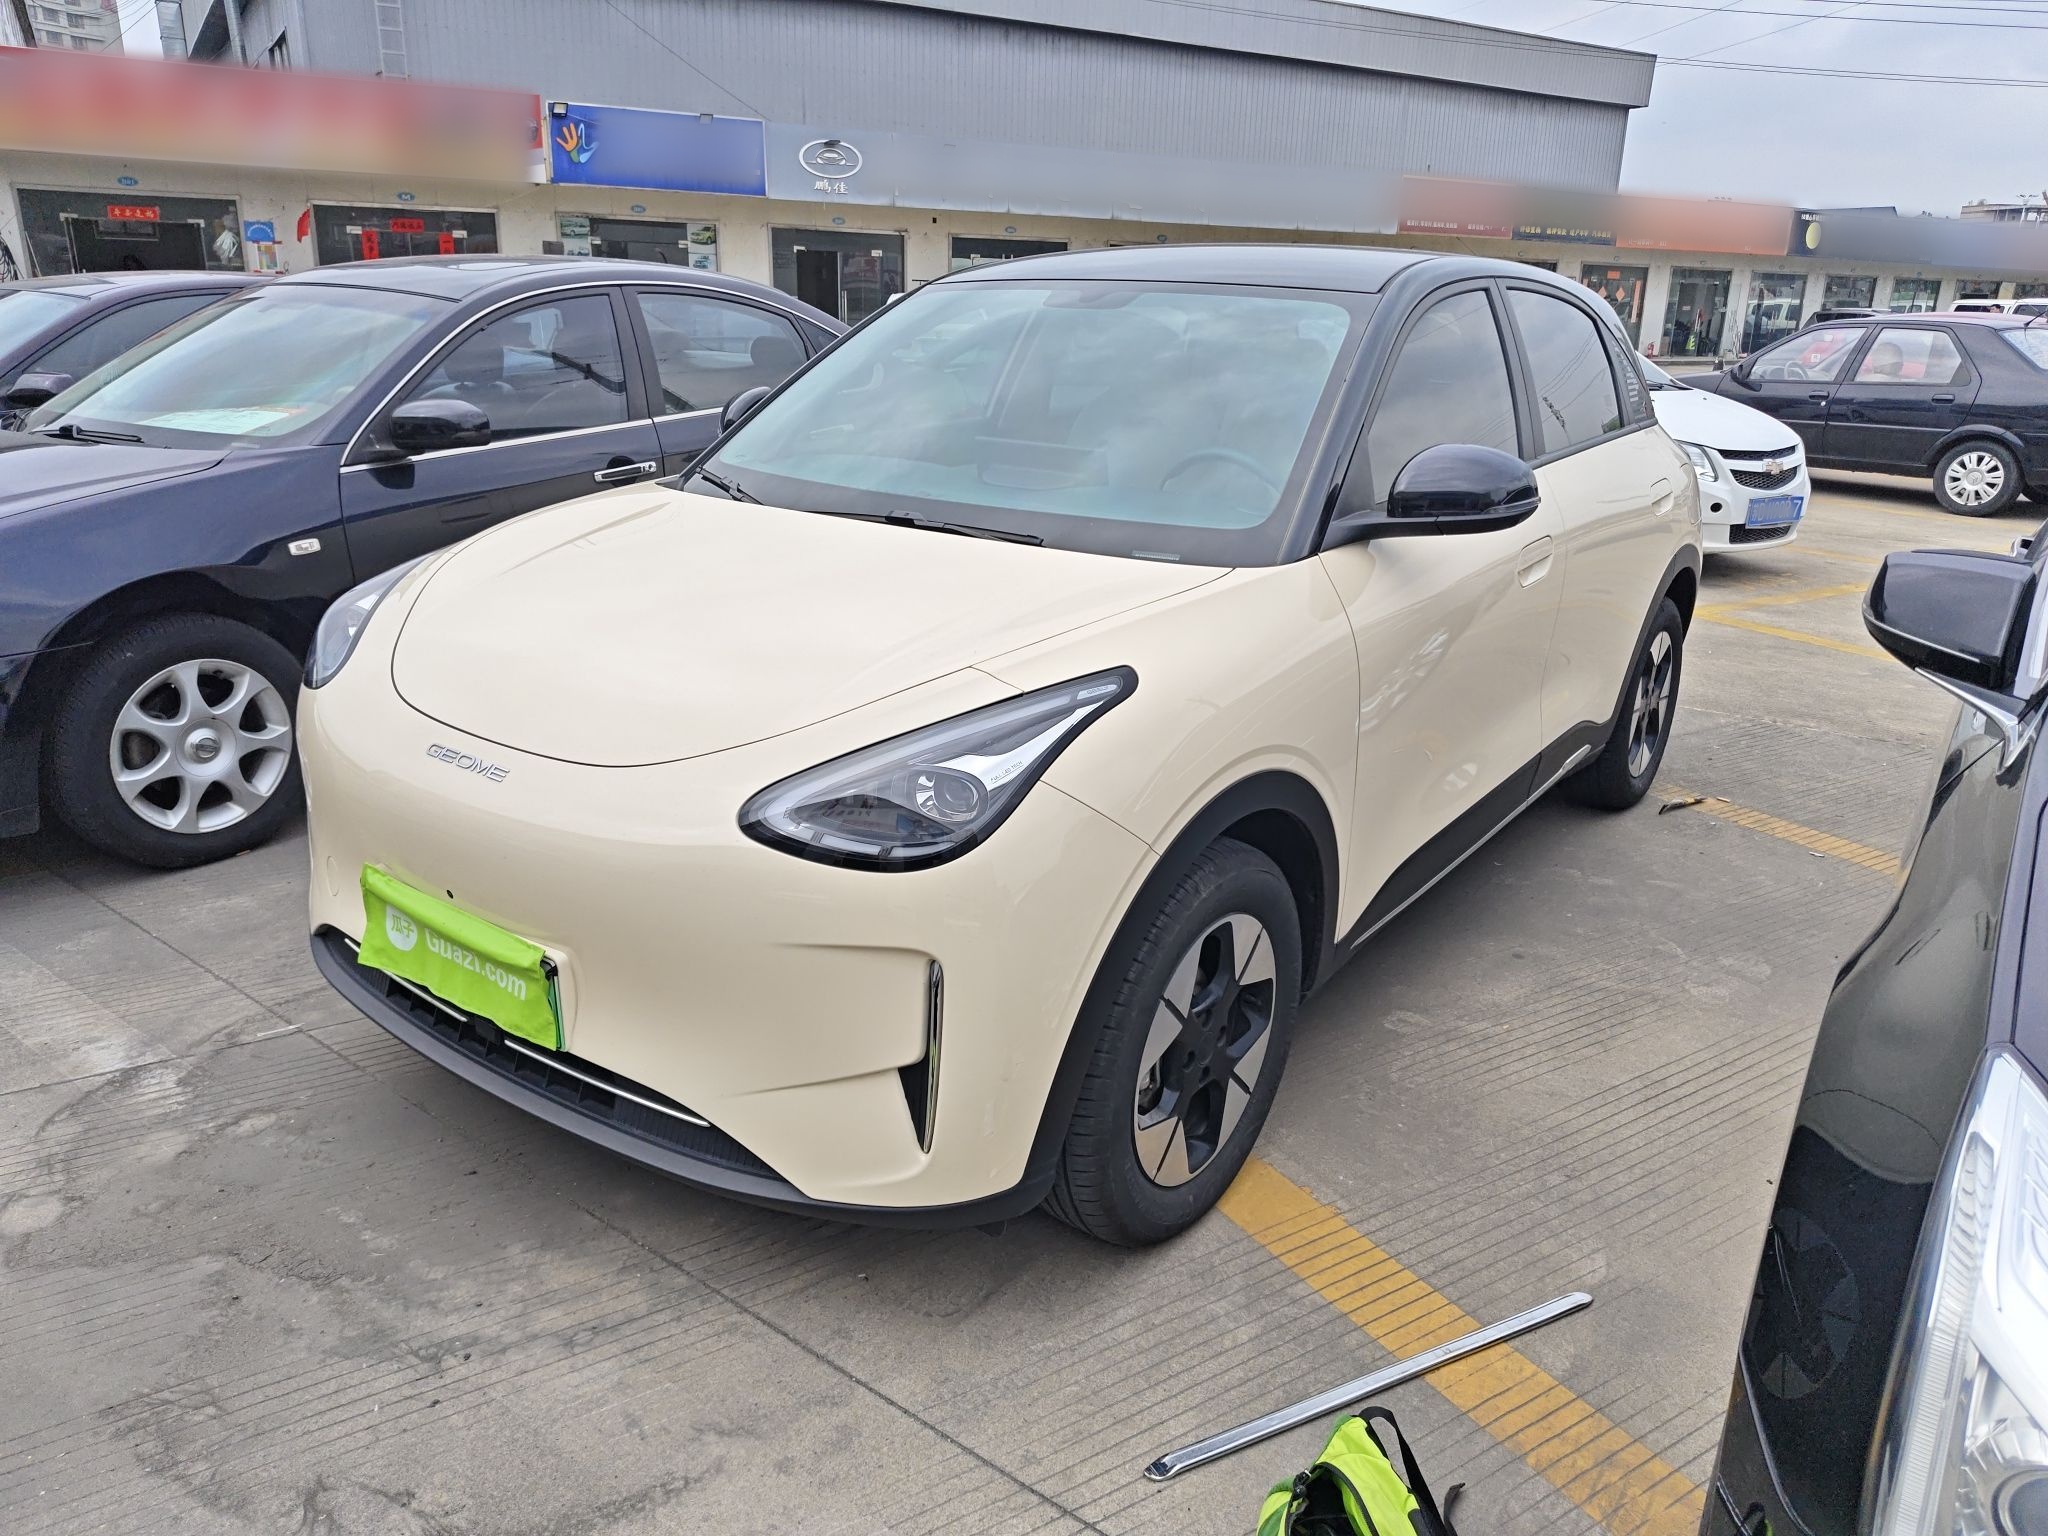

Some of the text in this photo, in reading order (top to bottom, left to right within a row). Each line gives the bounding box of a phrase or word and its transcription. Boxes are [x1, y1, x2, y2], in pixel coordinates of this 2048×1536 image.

[814, 179, 848, 194] 鹏佳
[426, 743, 510, 783] GEOME
[391, 913, 415, 940] 瓜子
[424, 927, 527, 1001] Guazi.com
